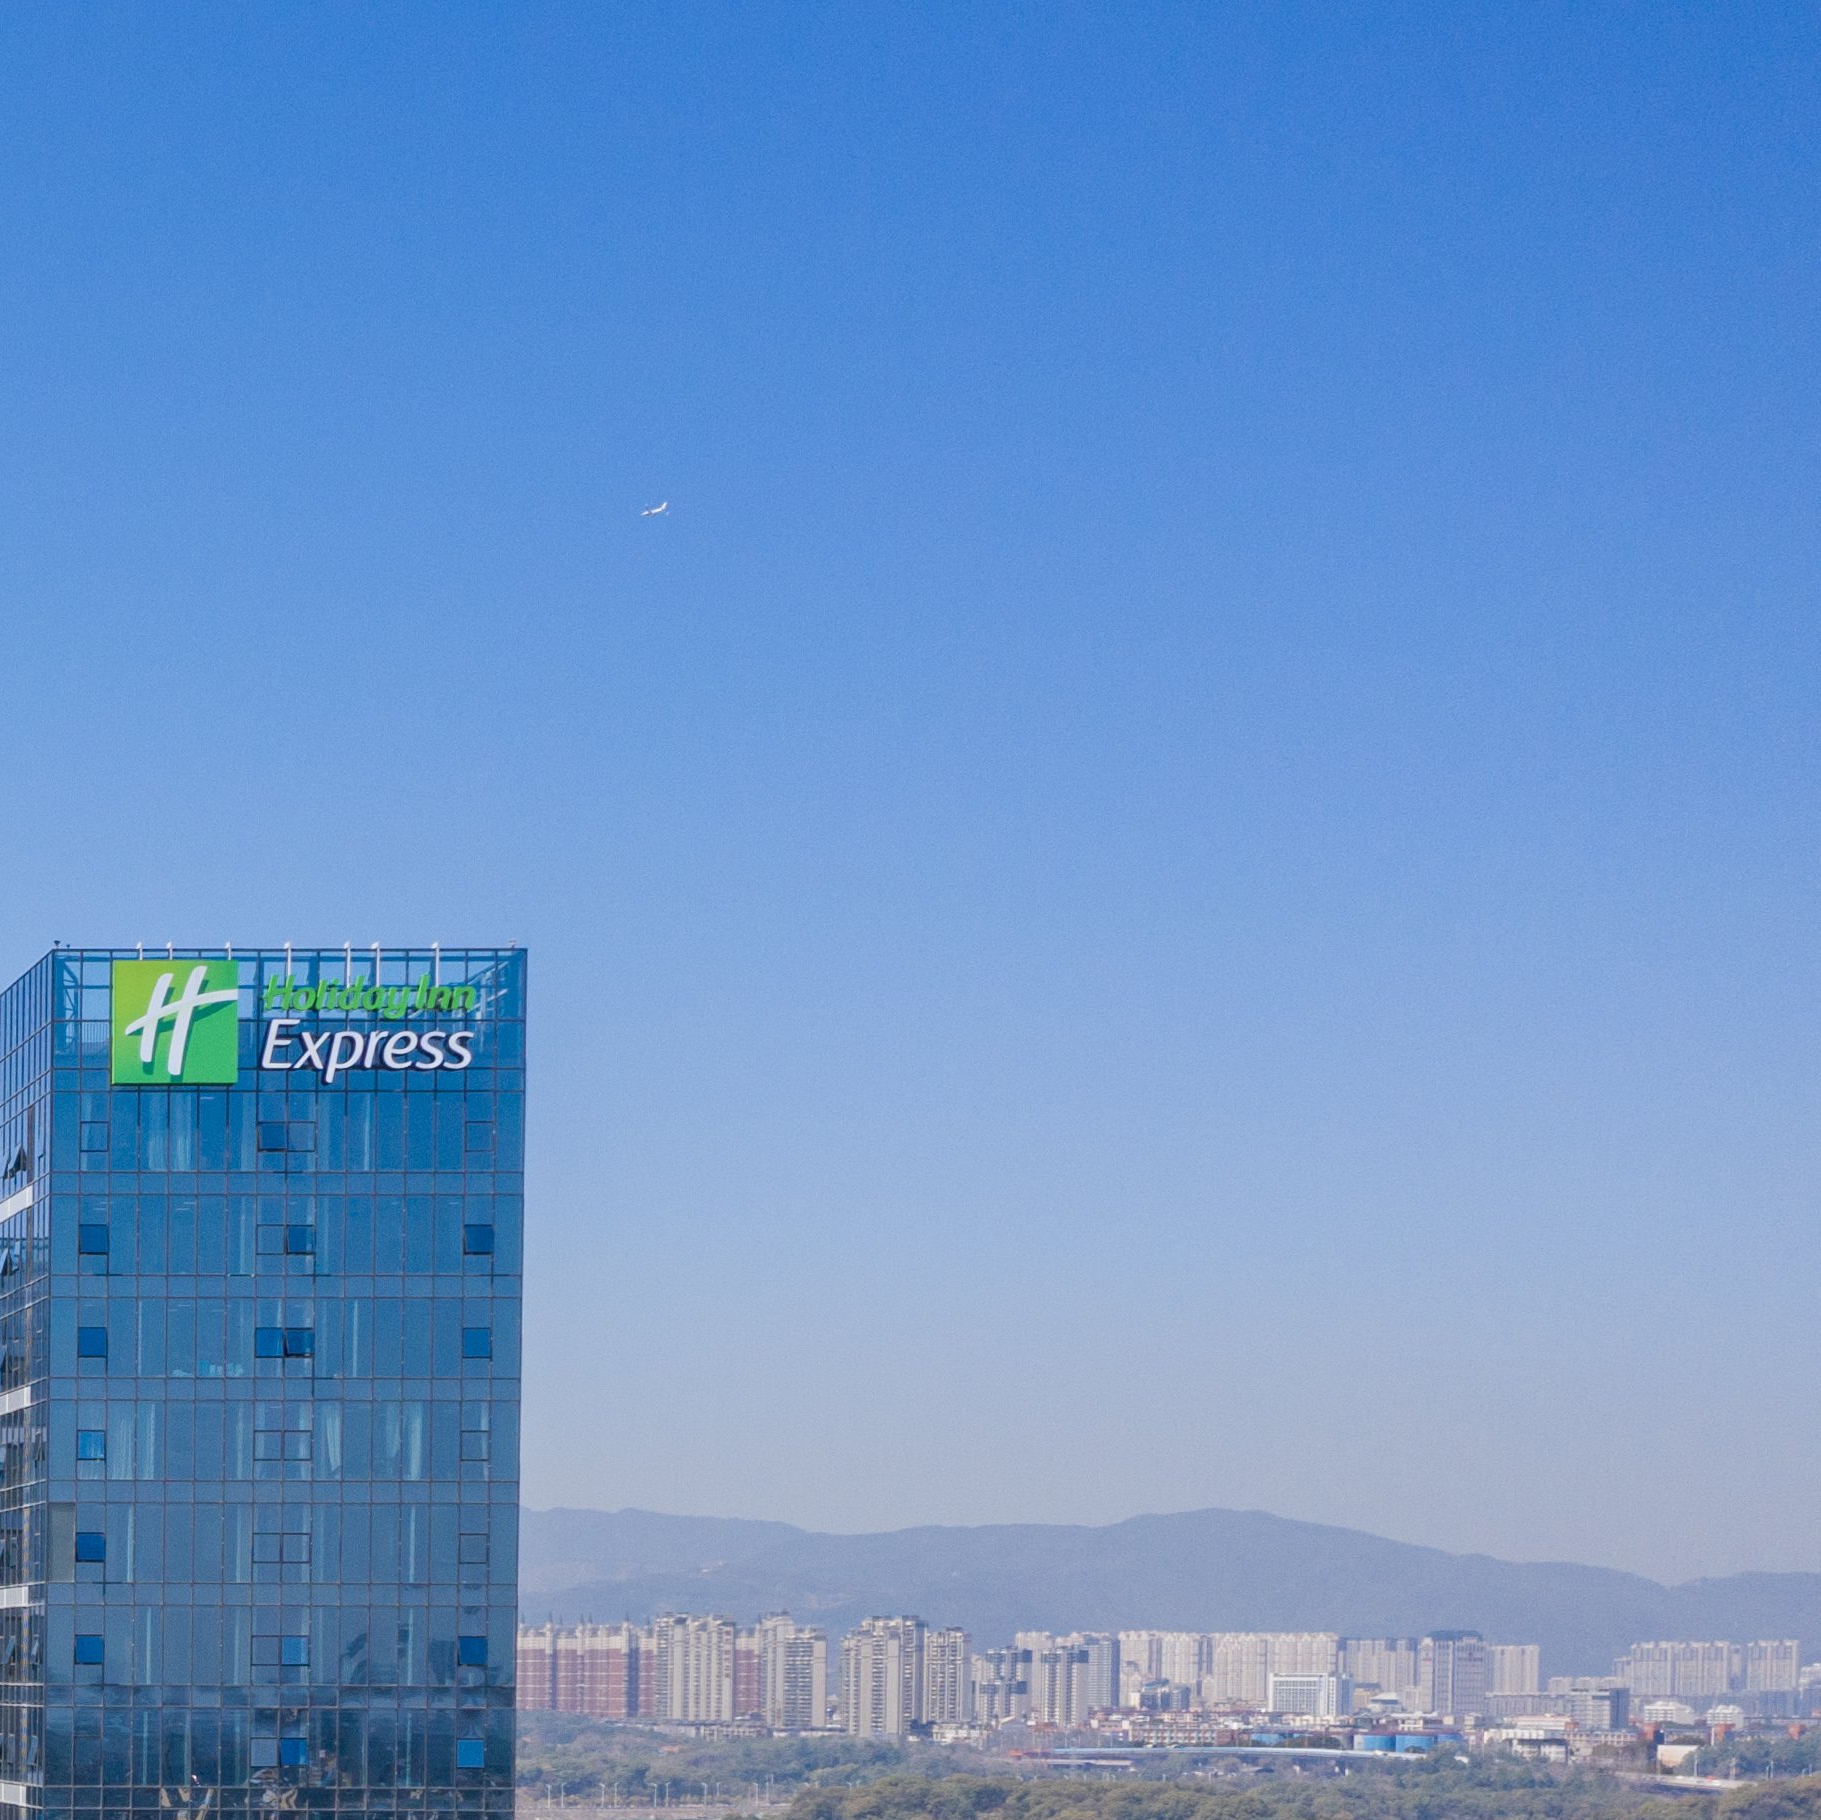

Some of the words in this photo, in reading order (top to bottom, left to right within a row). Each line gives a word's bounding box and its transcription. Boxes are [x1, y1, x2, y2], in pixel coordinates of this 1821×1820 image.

[262, 974, 413, 1019] Holiday
[413, 974, 477, 1010] Inn
[261, 1018, 475, 1084] Express
